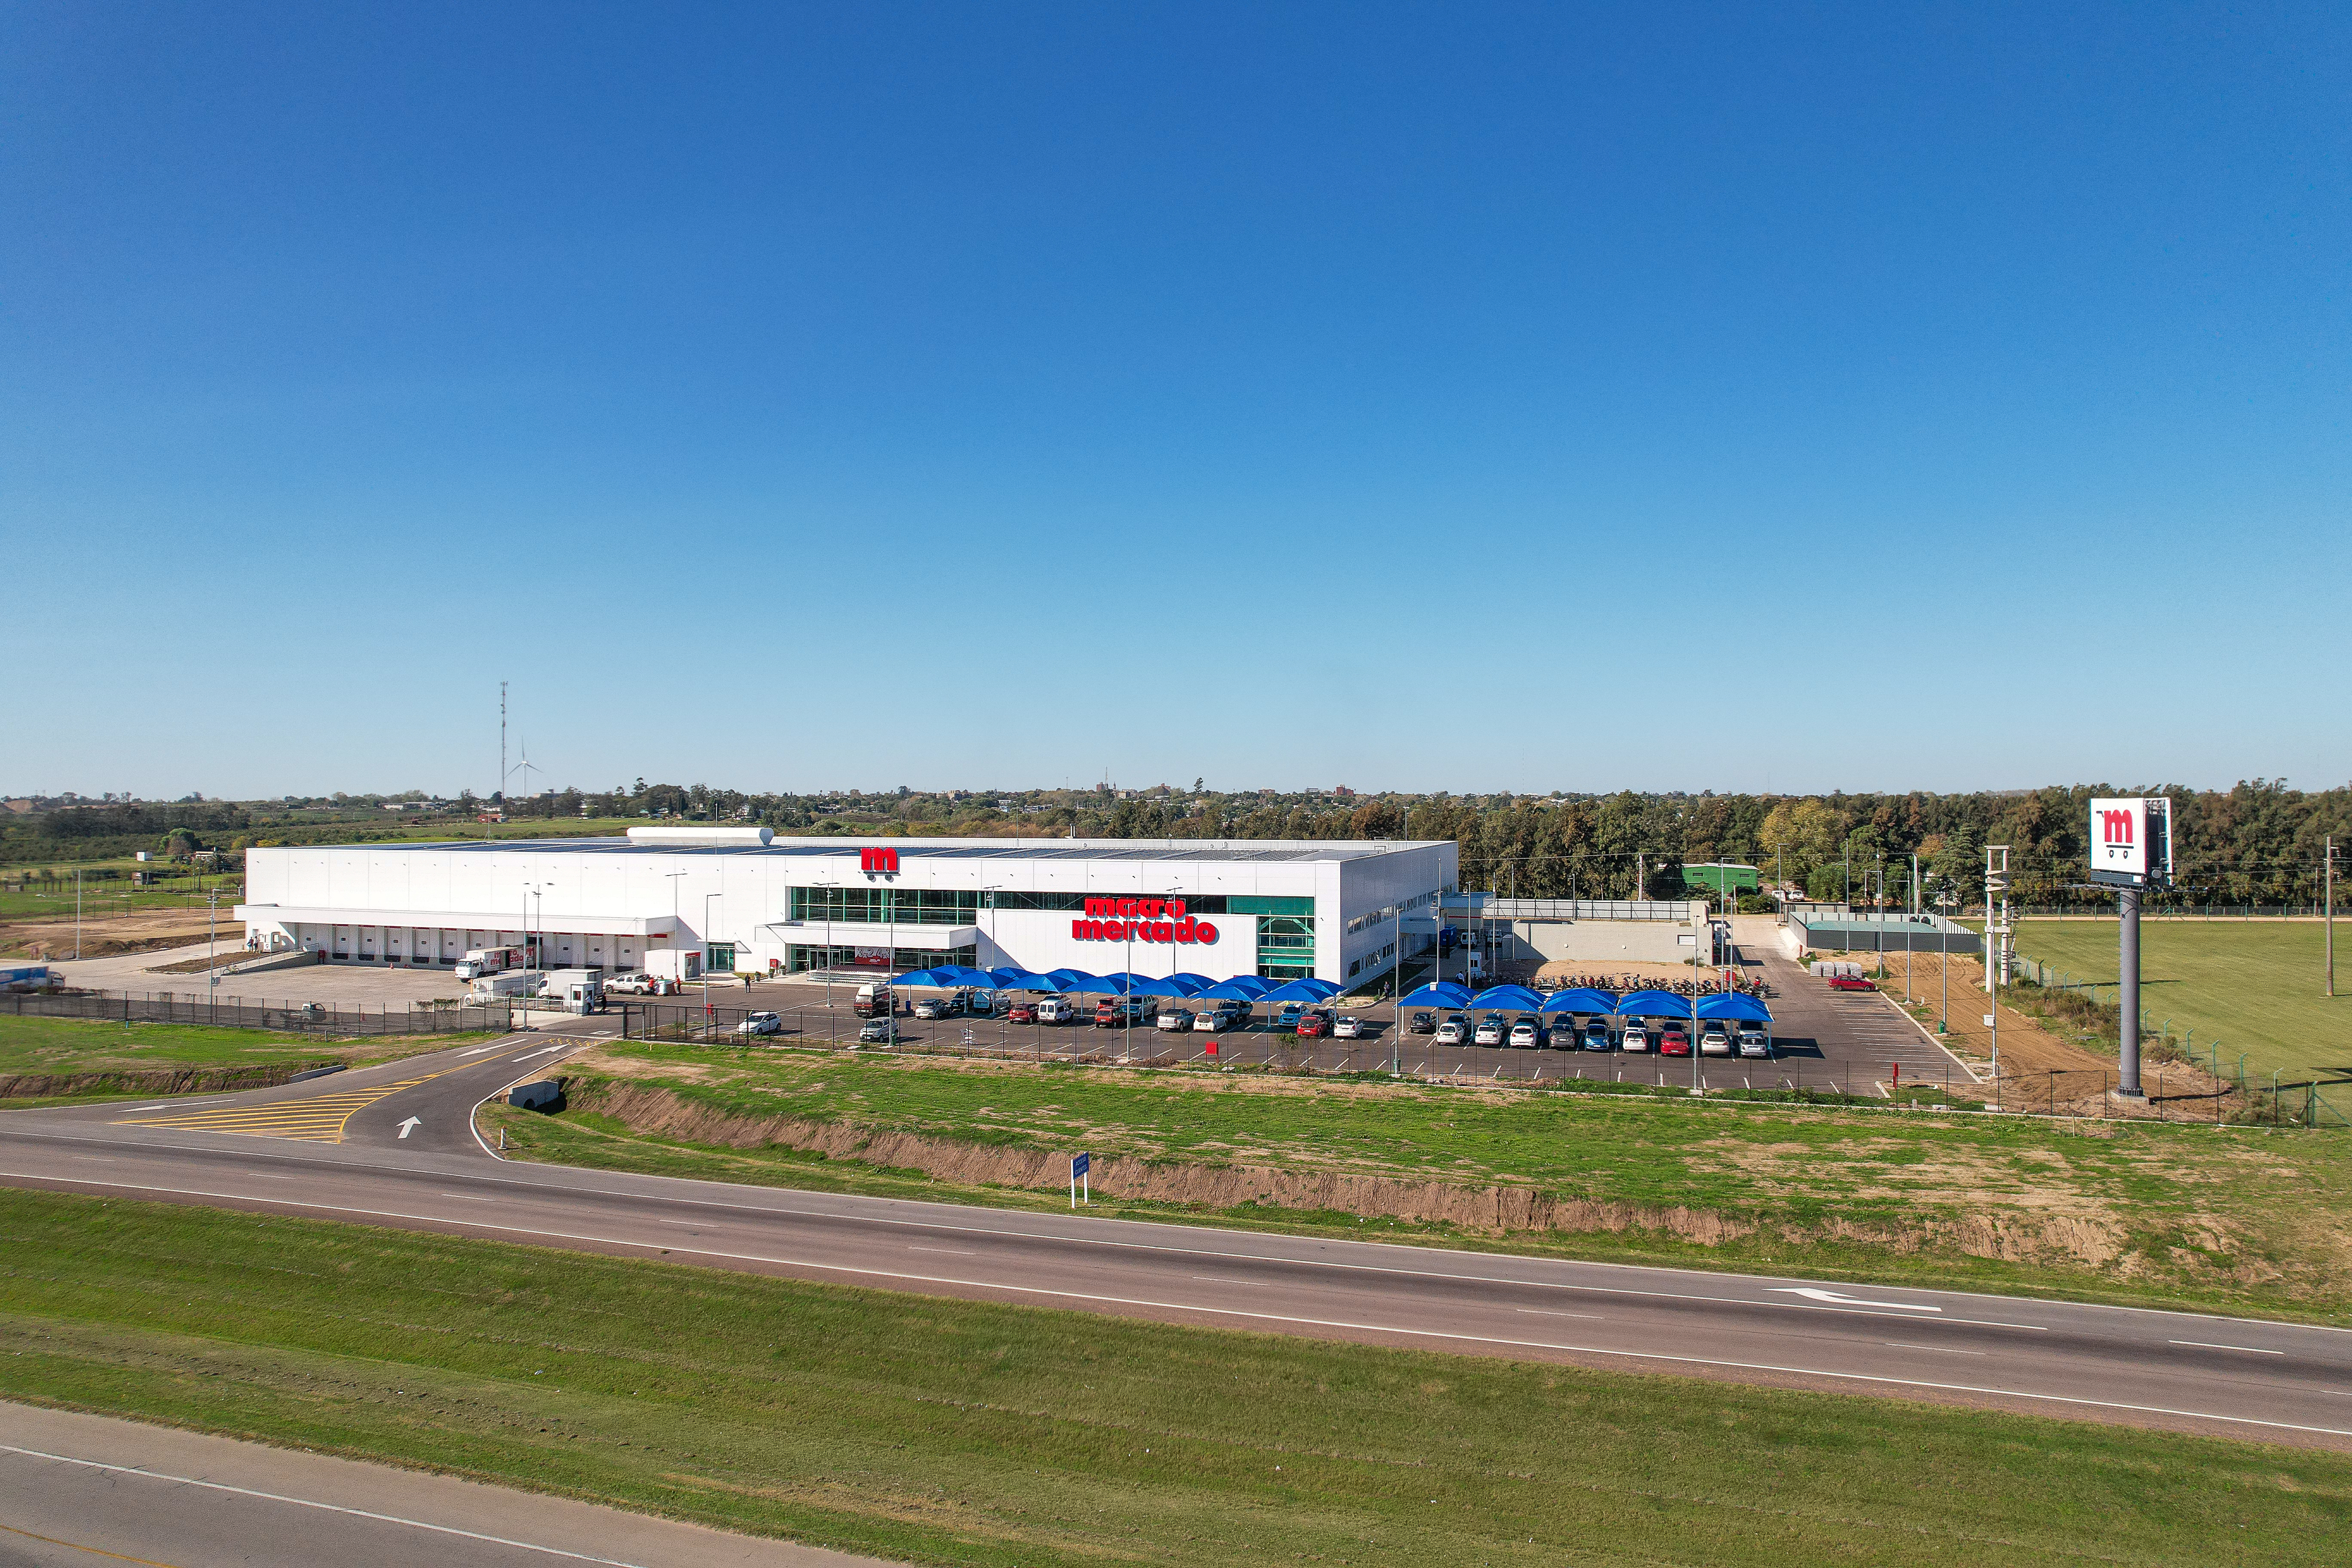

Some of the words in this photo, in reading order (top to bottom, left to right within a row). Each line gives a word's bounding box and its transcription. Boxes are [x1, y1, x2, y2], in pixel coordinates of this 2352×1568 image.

[2104, 809, 2133, 843] m
[861, 847, 897, 870] m
[1085, 898, 1185, 919] macro
[1072, 916, 1216, 943] mercado
[1075, 1156, 1086, 1167] ACCESO
[1075, 1164, 1087, 1175] CLIENTES
